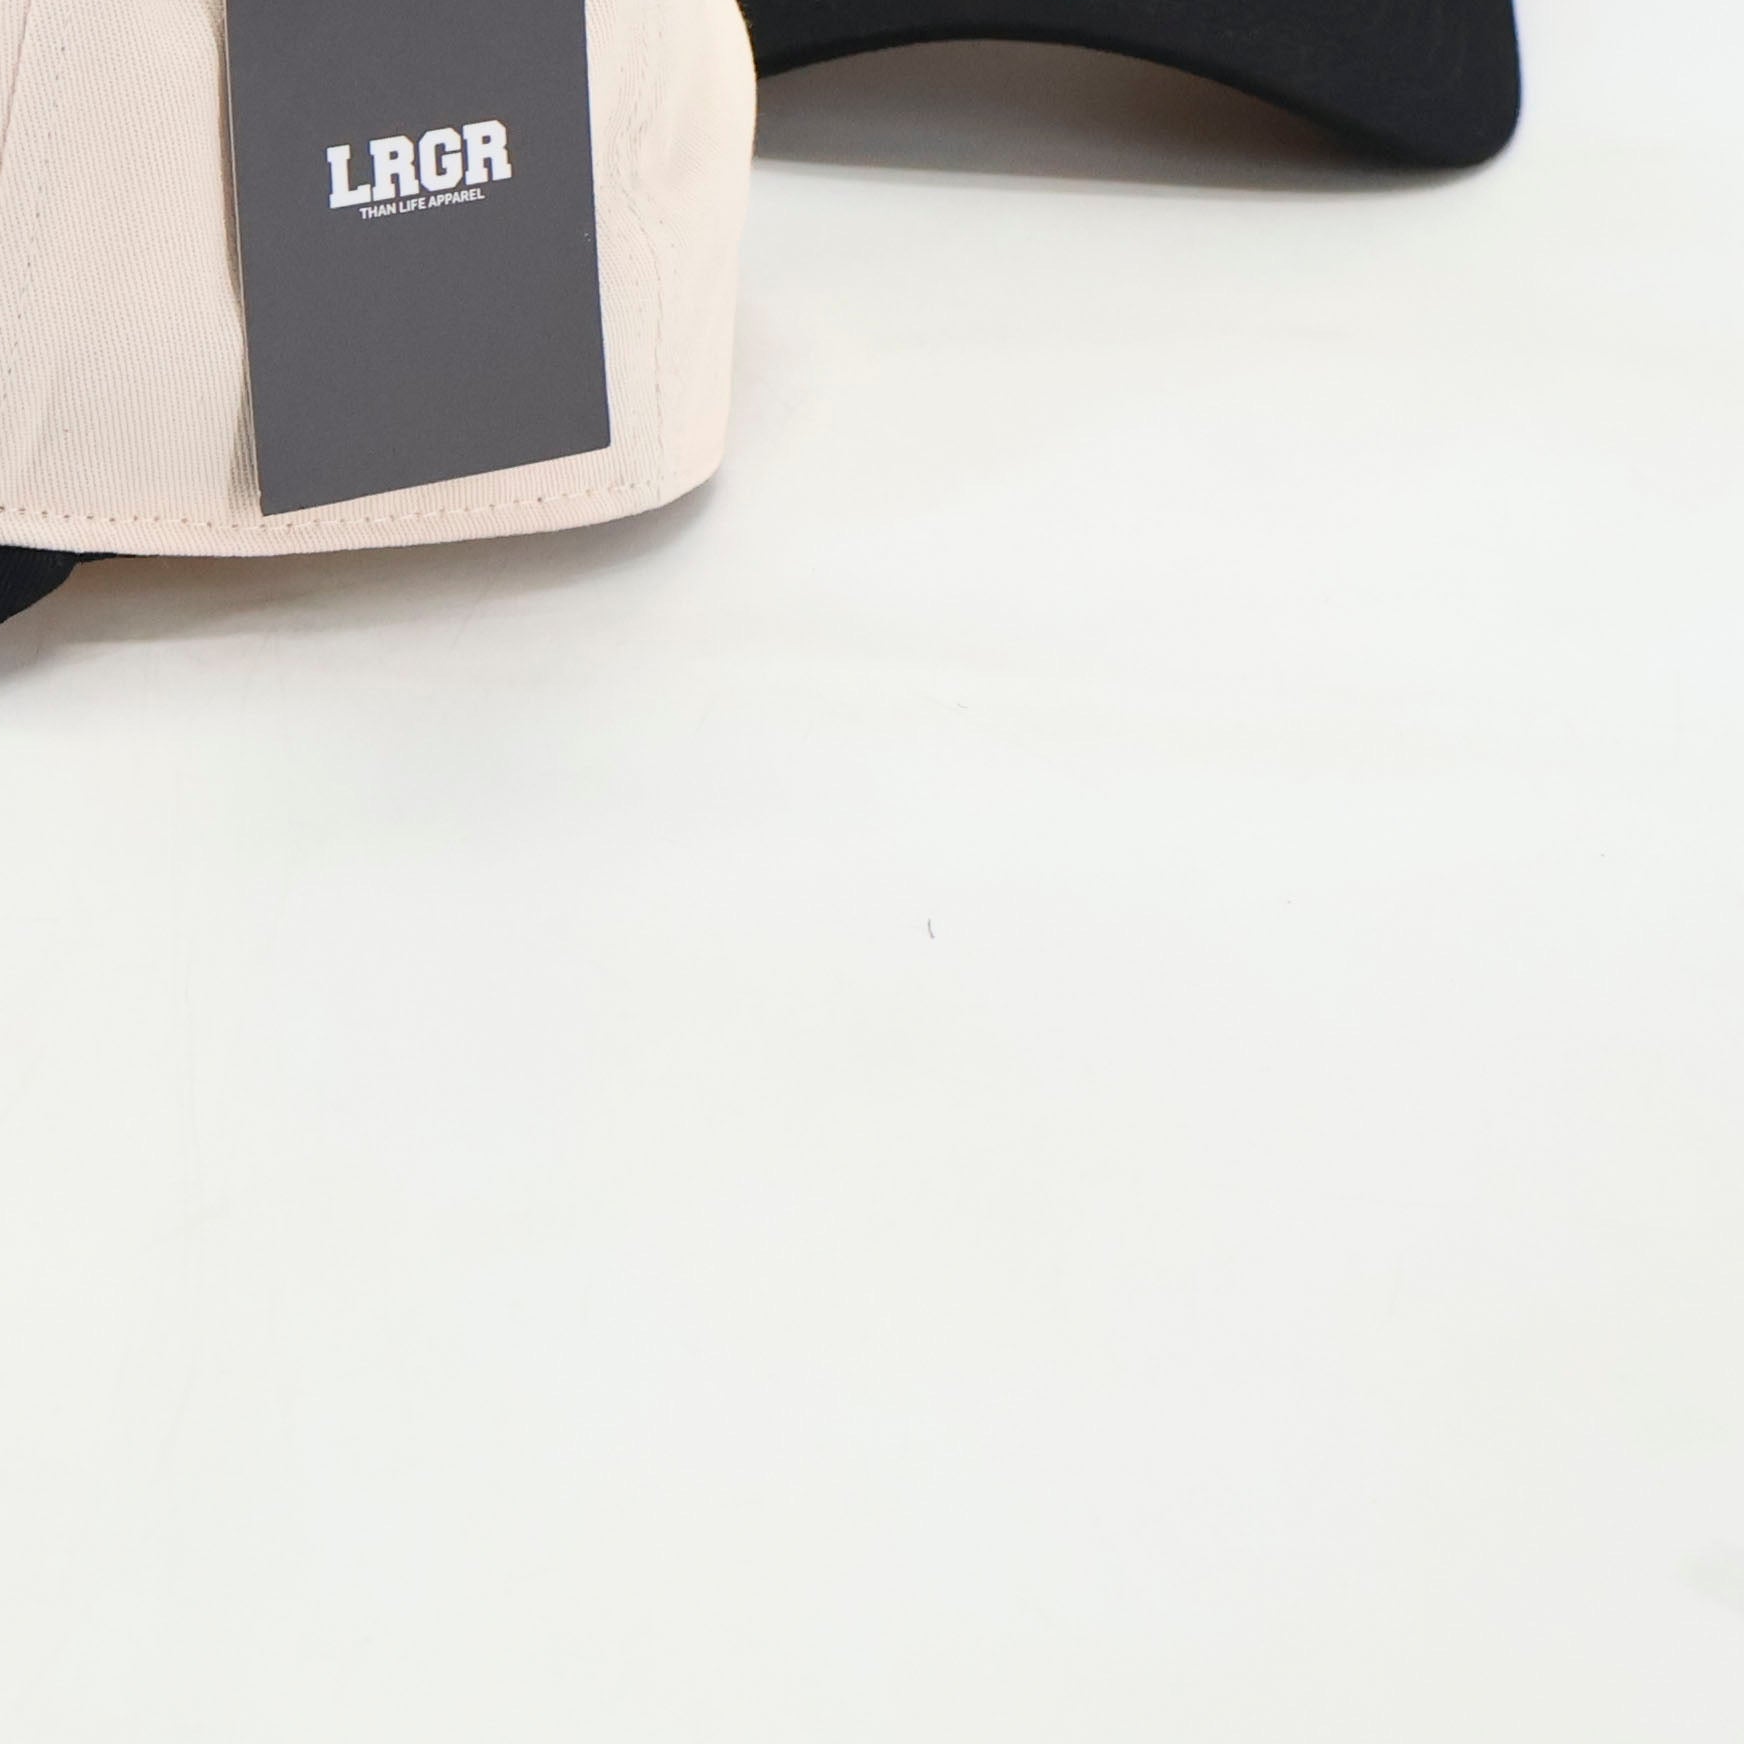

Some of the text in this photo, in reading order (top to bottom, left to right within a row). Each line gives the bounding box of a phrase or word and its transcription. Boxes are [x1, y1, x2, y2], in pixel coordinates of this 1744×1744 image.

[326, 119, 513, 209] LRGR
[359, 188, 485, 219] THAN LIFE APPAREL
